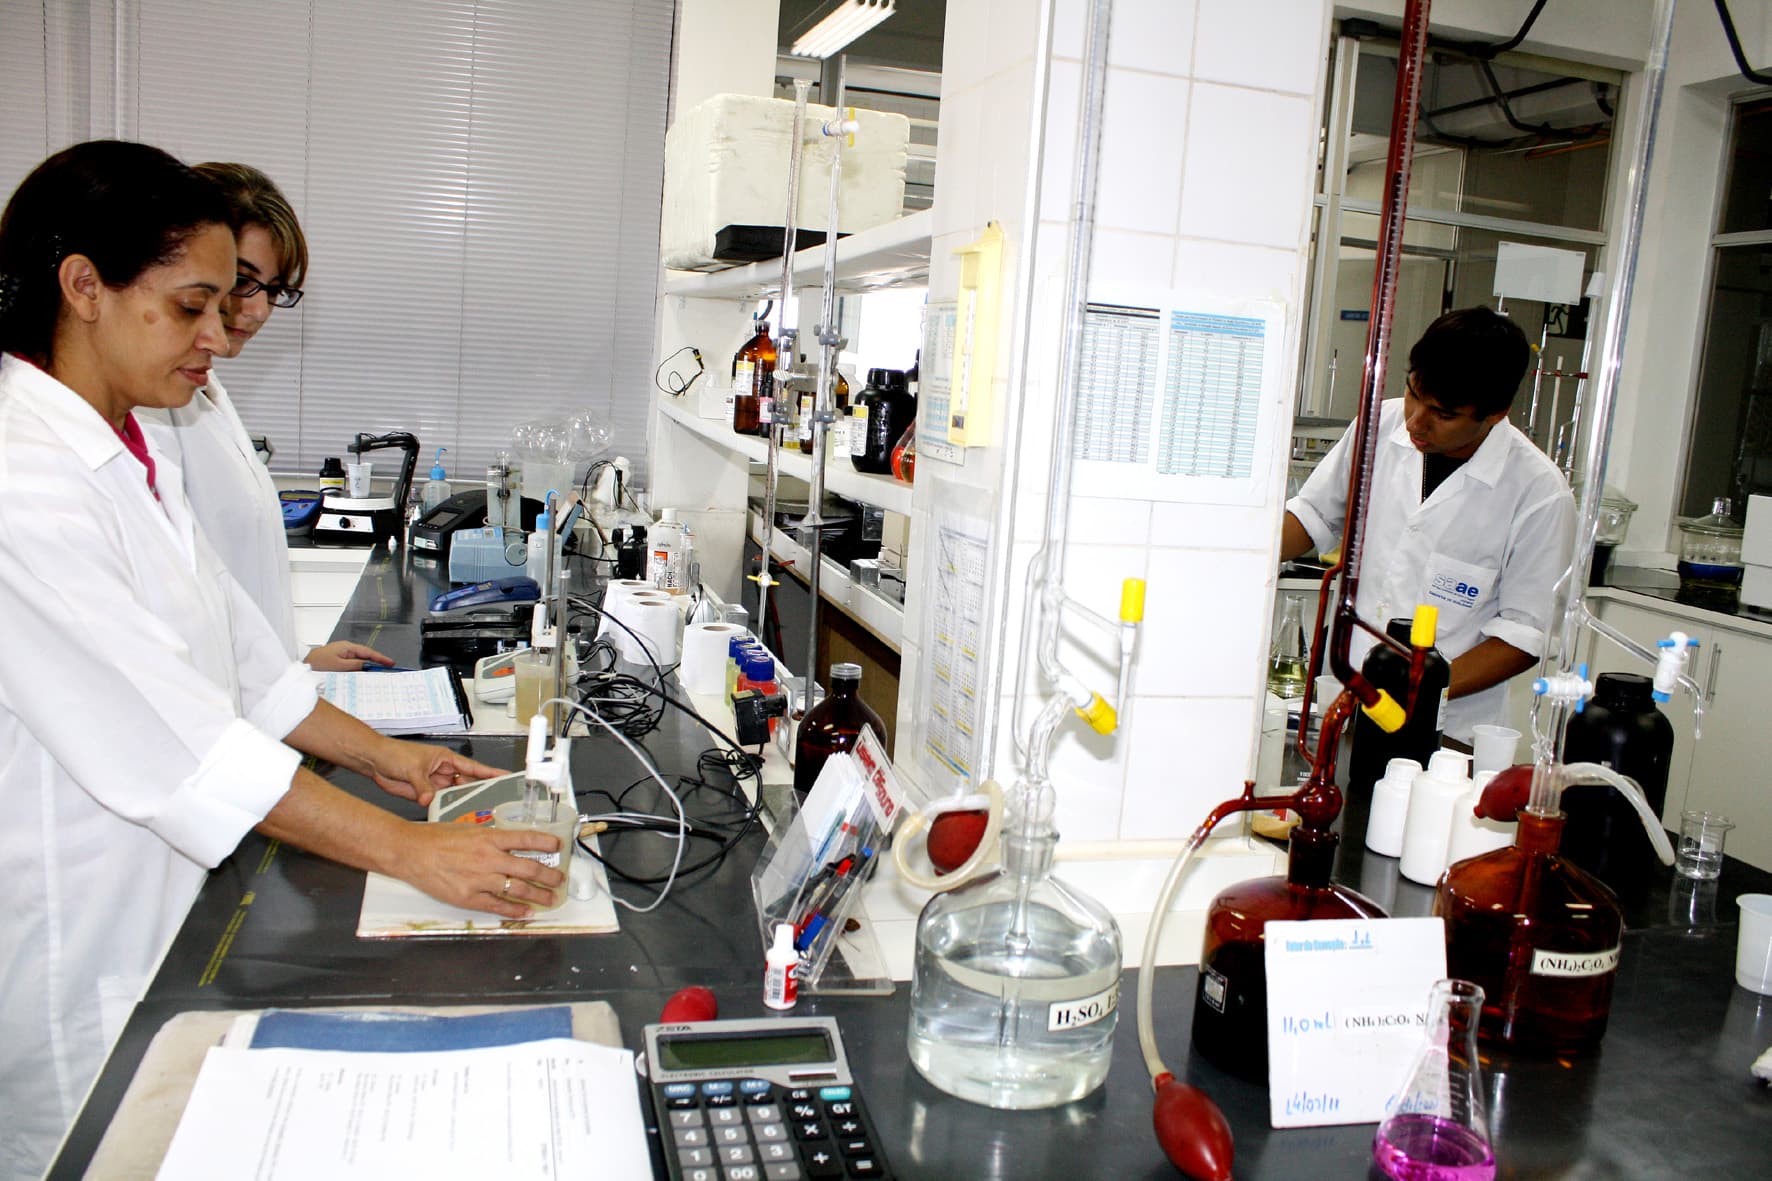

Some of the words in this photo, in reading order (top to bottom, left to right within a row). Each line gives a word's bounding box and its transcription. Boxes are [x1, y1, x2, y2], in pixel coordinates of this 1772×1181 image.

[679, 1111, 692, 1123] 7
[719, 1109, 733, 1121] 8
[684, 1130, 697, 1142] 4
[724, 1128, 738, 1140] 5
[763, 1125, 777, 1137] 6
[690, 1150, 701, 1161] 1
[730, 1147, 744, 1160] 2
[769, 1144, 784, 1157] 3
[693, 1169, 707, 1181] 0
[730, 1167, 754, 1180] 00
